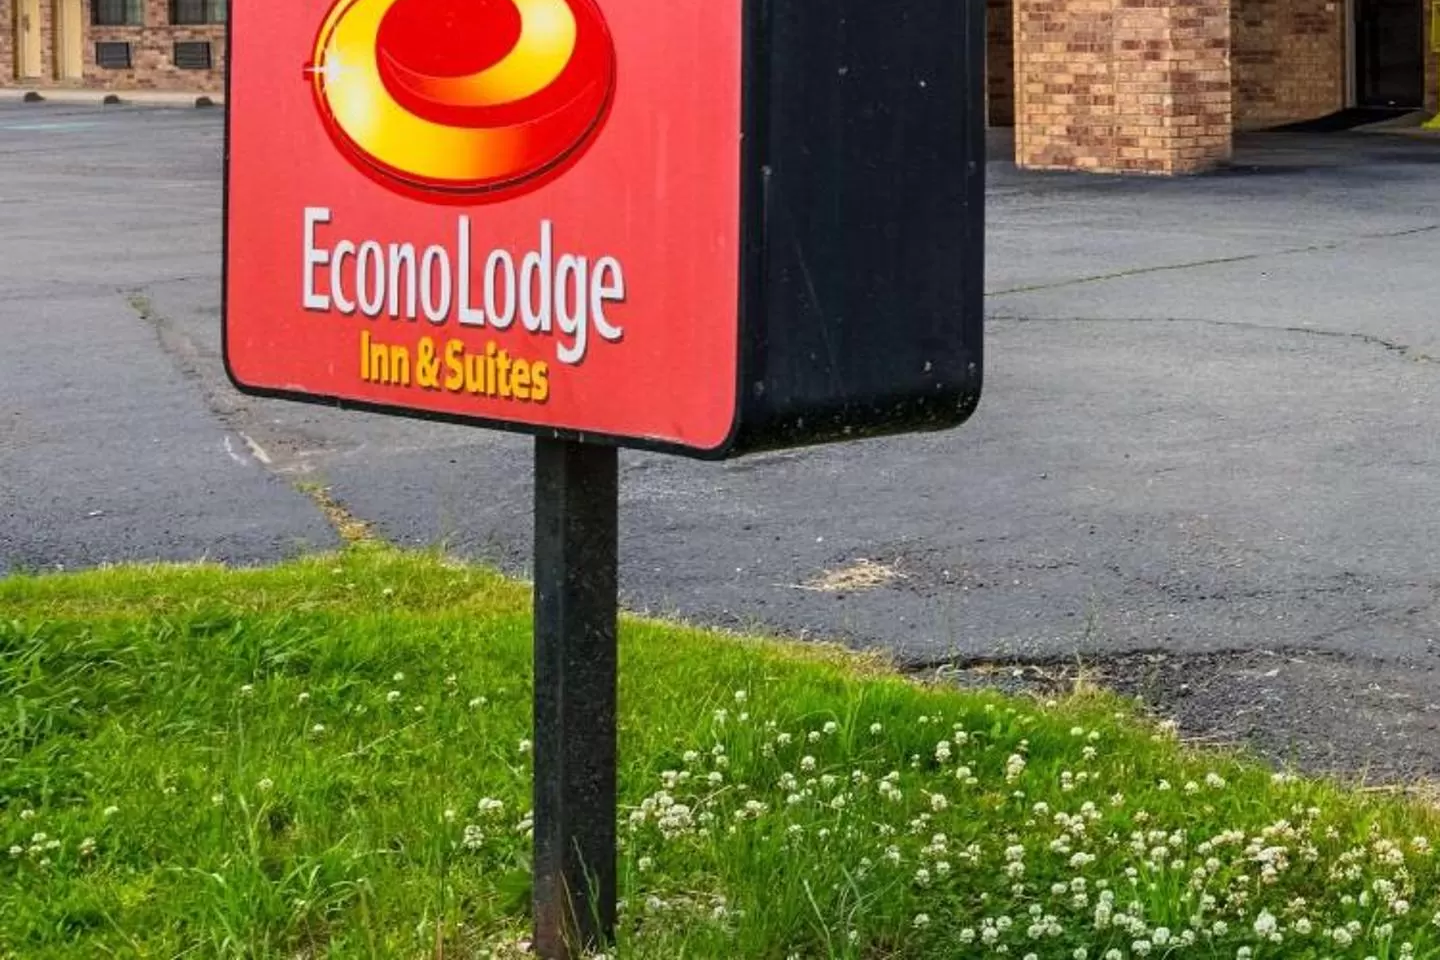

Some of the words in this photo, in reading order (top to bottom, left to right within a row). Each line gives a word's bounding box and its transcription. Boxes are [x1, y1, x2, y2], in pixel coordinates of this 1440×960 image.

[303, 206, 626, 363] EconoLodge
[360, 330, 411, 386] Inn
[415, 336, 441, 389] &
[445, 339, 549, 402] Suites
